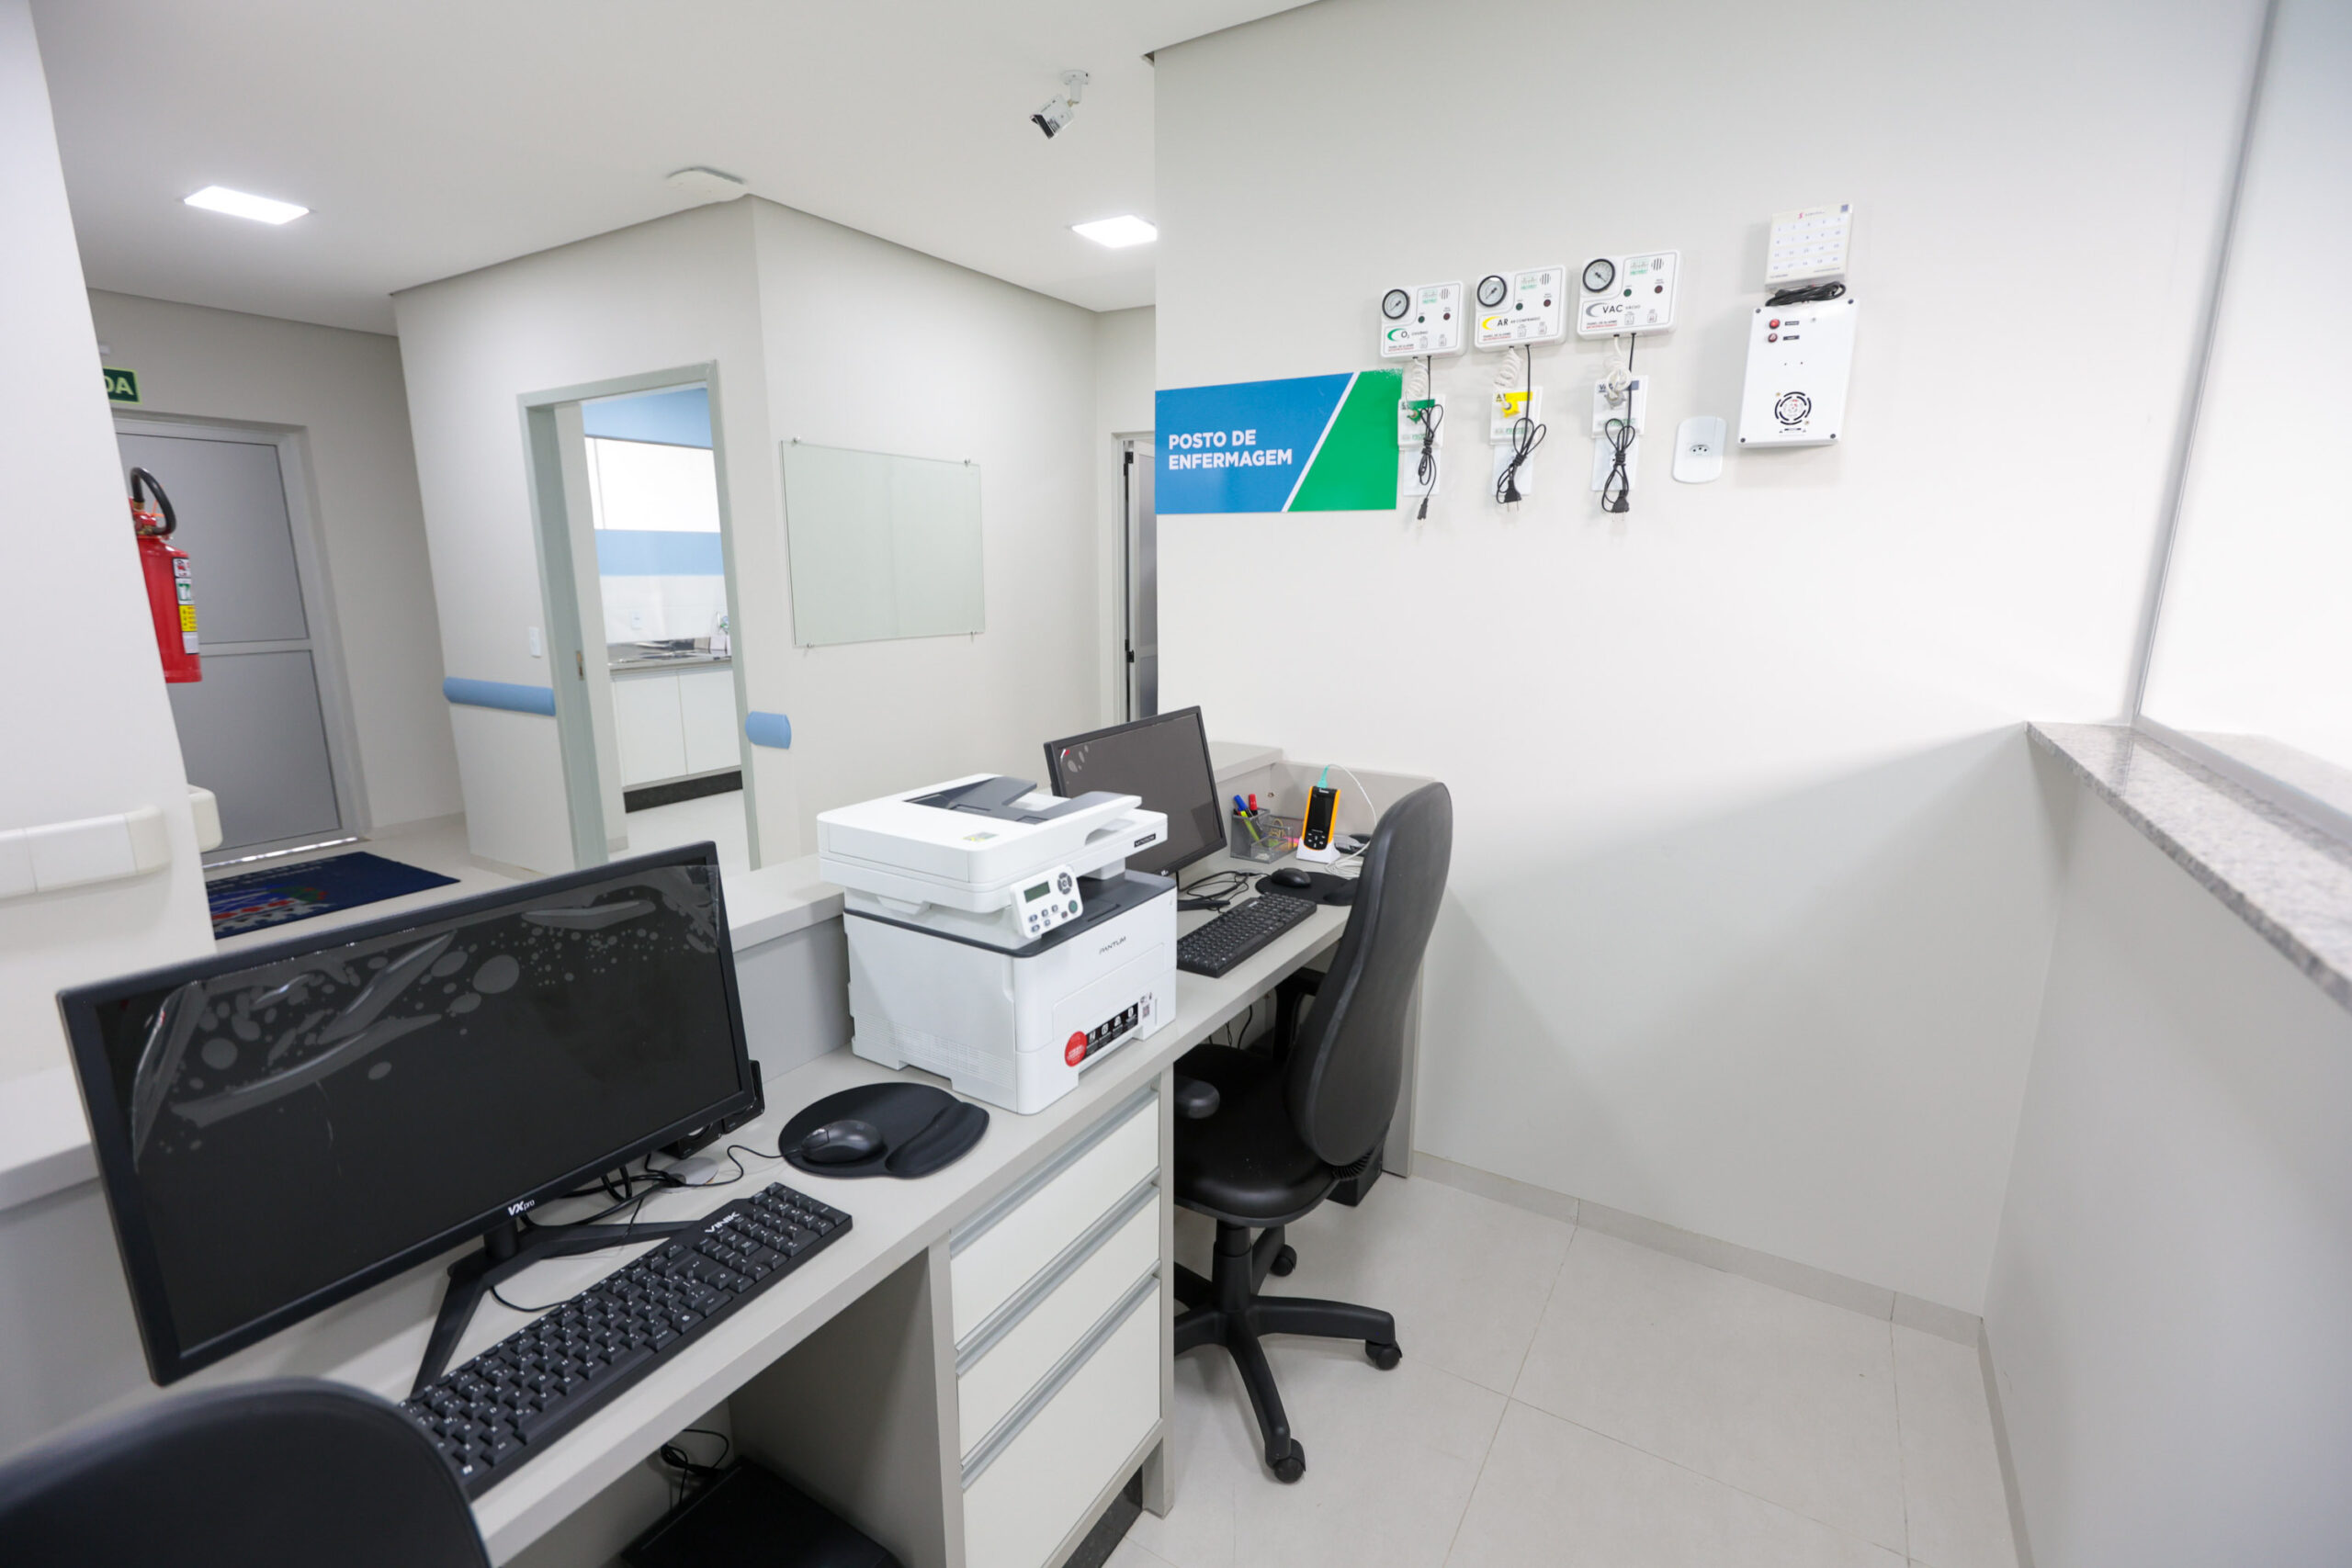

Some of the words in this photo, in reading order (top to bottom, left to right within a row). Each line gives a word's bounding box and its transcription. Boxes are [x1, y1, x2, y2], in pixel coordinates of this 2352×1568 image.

[1602, 304, 1623, 314] VAC
[1497, 318, 1509, 326] AR
[1169, 431, 1227, 450] POSTO
[1232, 429, 1257, 446] DE
[1169, 448, 1293, 470] ENFERMAGEM
[704, 1212, 741, 1233] VINIK
